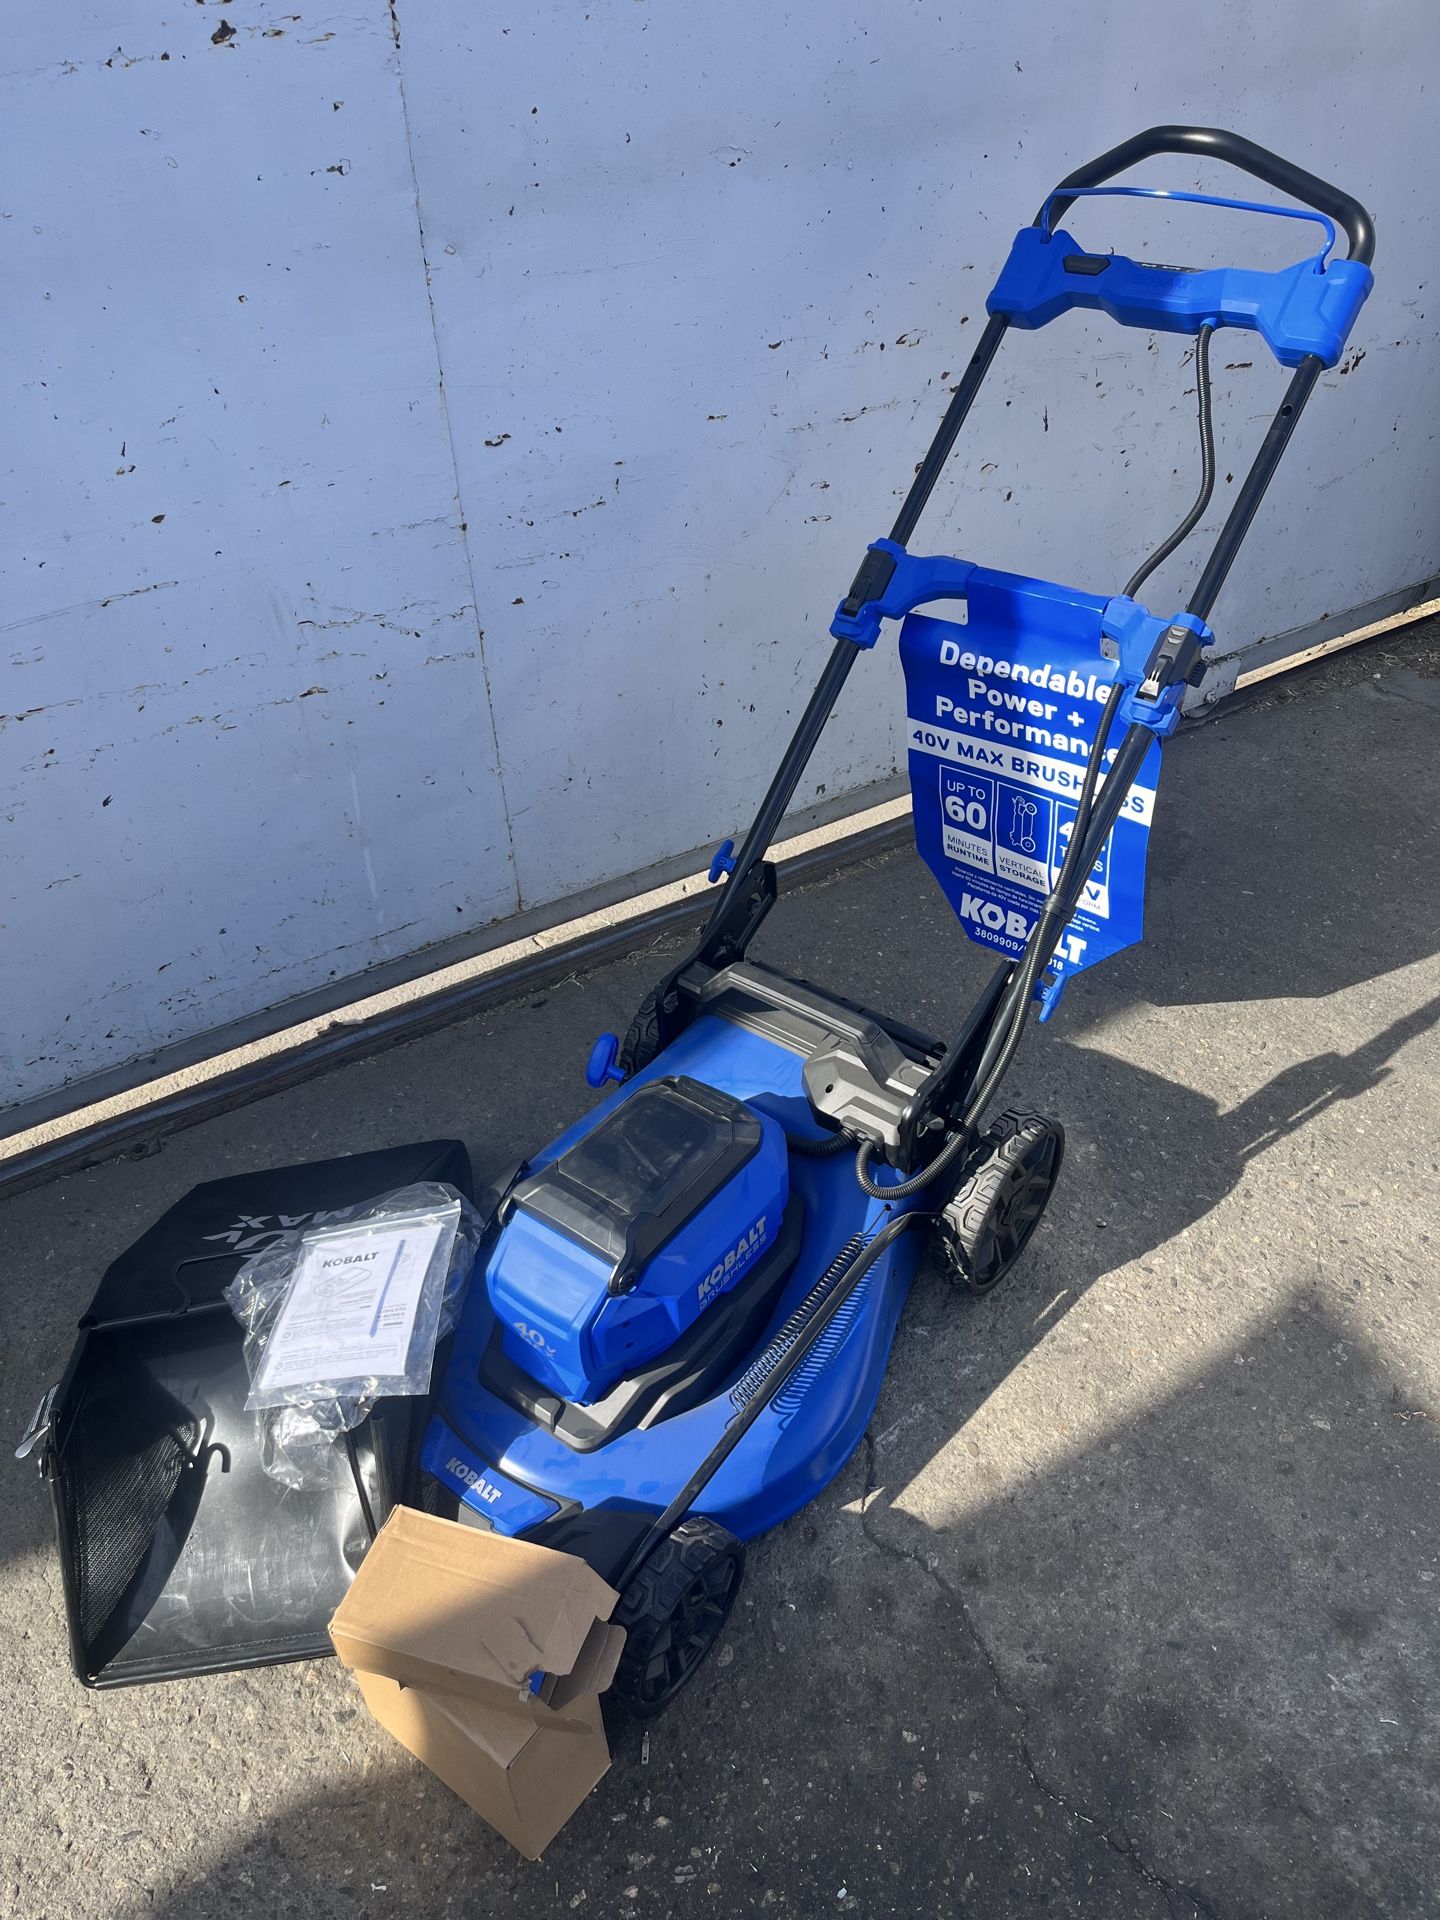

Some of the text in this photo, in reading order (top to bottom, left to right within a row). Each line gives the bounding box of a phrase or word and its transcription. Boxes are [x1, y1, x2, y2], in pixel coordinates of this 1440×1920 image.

[939, 639, 1112, 704] Dependable
[968, 678, 1085, 728] Power +
[912, 729, 950, 751] 40V
[957, 741, 1004, 767] MAX
[947, 779, 986, 800] UP TO
[945, 795, 987, 830] 60
[947, 834, 988, 857] MINUTES
[947, 843, 989, 865] RUNTIME
[999, 855, 1044, 878] VERTICAL
[999, 864, 1046, 887] STORAGE
[960, 892, 1087, 964] KOBLT
[322, 1251, 380, 1268] KOBALT
[697, 1215, 767, 1300] KOBALT
[699, 1232, 767, 1311] BRUSHLESS
[444, 1456, 503, 1504] KOBALT
